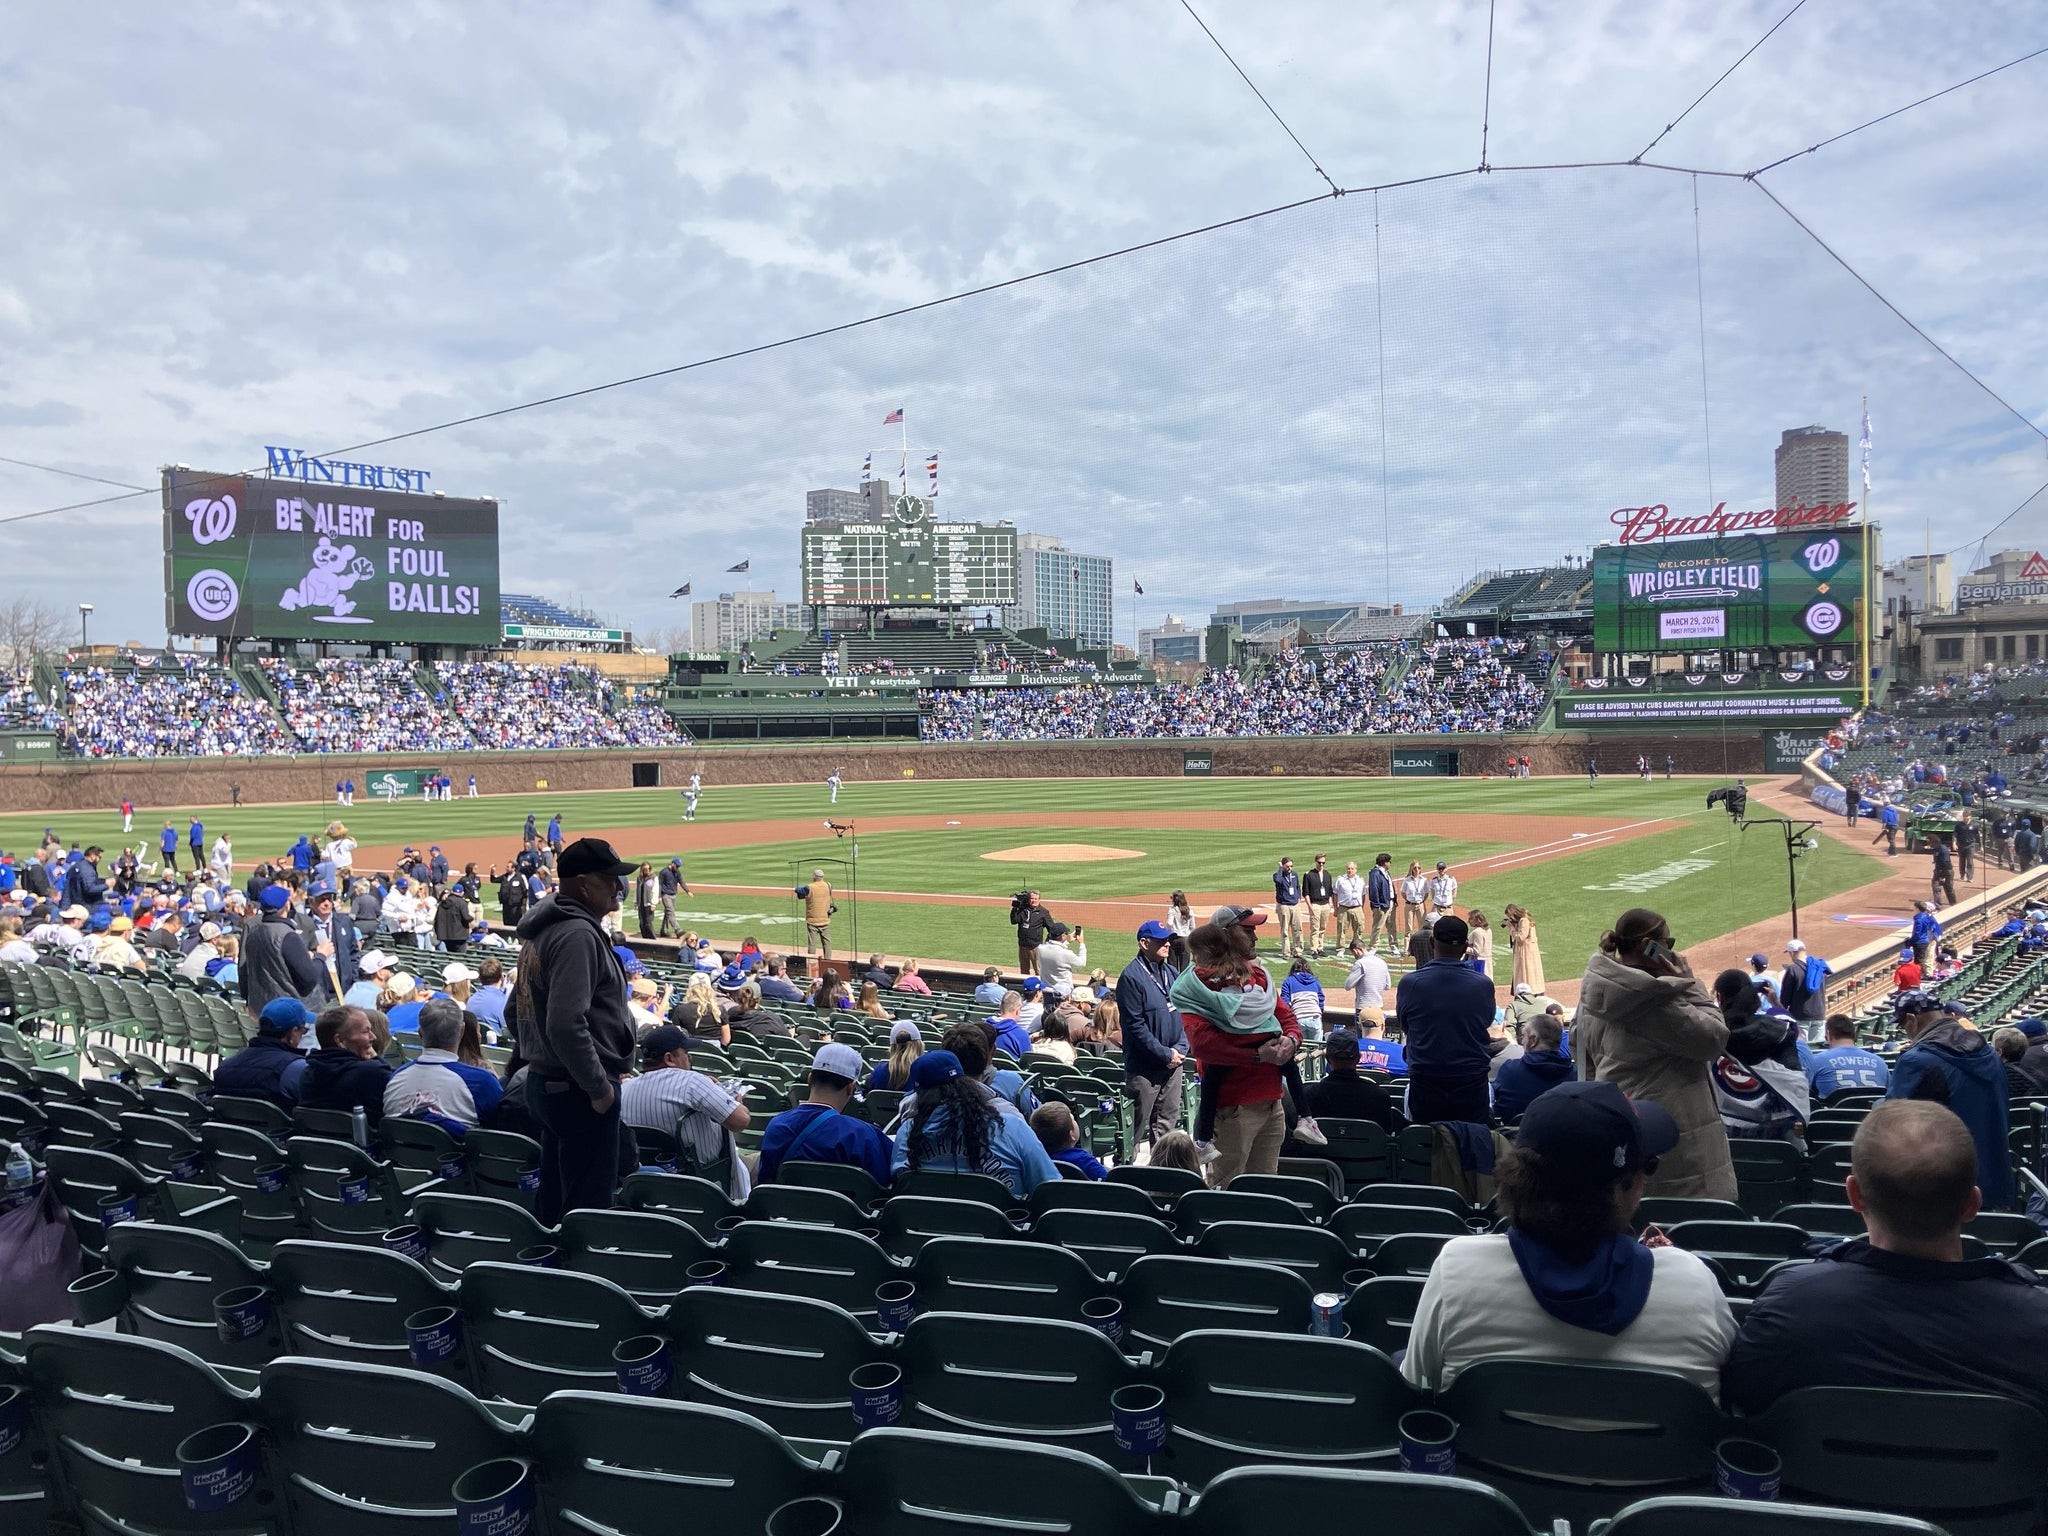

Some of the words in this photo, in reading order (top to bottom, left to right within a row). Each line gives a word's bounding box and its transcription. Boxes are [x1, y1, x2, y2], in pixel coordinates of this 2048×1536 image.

[185, 494, 237, 545] W
[276, 498, 303, 531] BE
[314, 502, 375, 537] ALERT
[1610, 496, 1857, 544] Budweiser
[388, 518, 424, 542] FOR
[844, 525, 888, 534] NATIONAL
[932, 525, 976, 533] AMERICAN
[1804, 539, 1840, 572] W
[388, 547, 449, 577] FOUL
[1658, 558, 1711, 569] WELCOME
[1714, 557, 1729, 565] TO
[1628, 567, 1707, 598] WRIGLEY
[1711, 565, 1759, 590] FIELD
[1960, 581, 2048, 600] Benjamin
[388, 582, 480, 615] BALLS!
[1666, 617, 1689, 626] MARCH
[1690, 617, 1700, 626] 29,
[1702, 616, 1720, 625] 2026
[521, 627, 608, 639] WRIGLEYROOFTOPS.COM
[697, 652, 721, 661] Mobile
[825, 677, 858, 687] YETI
[876, 677, 921, 687] tastytrade
[969, 674, 1008, 682] GRAINGER
[1103, 672, 1143, 682] Advocate
[1663, 701, 1684, 709] GAMES
[1797, 698, 1815, 706] LIGHT
[1187, 760, 1210, 769] Hefty
[1393, 760, 1432, 768] SLOAN
[1829, 1056, 1878, 1068] POWERS
[1835, 1069, 1878, 1088] 55
[416, 1330, 440, 1342] Hefty
[428, 1335, 450, 1350] Hefty
[629, 1365, 653, 1376] Hefty
[641, 1370, 661, 1384] Hefty
[865, 1395, 889, 1406] Hefty
[1136, 1417, 1160, 1430] Hefty
[193, 1468, 227, 1486] Hefty
[211, 1472, 242, 1496] Hefty
[471, 1505, 505, 1523] Hefty
[488, 1511, 520, 1535] Hefty
